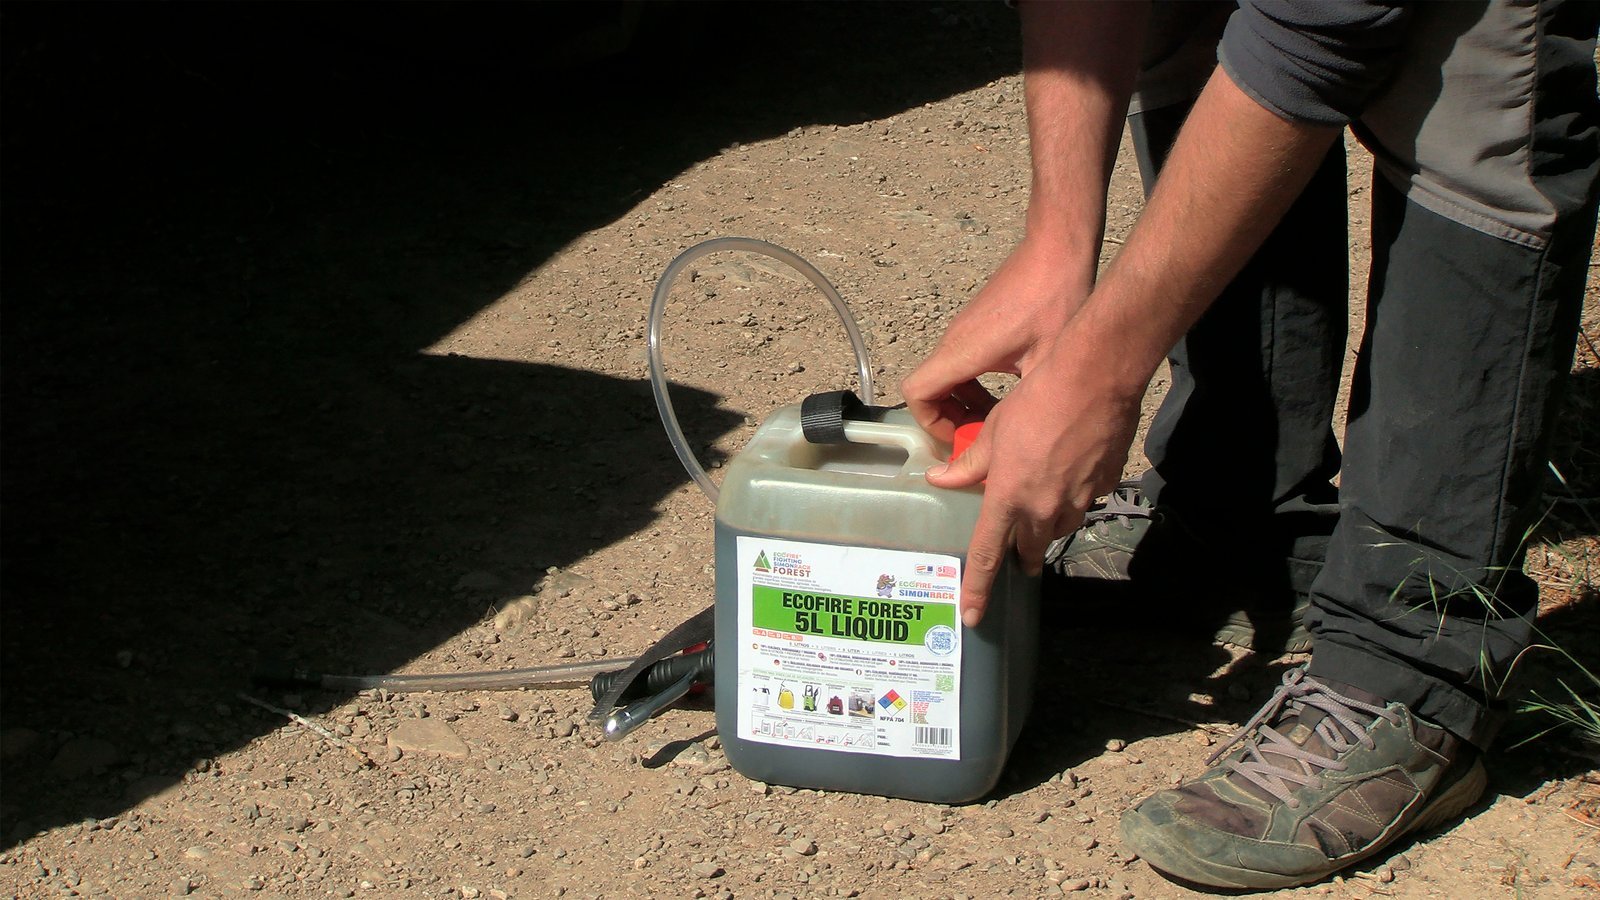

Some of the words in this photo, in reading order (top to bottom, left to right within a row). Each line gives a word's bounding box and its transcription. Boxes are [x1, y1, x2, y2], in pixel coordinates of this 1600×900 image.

[773, 561, 811, 570] SIMONRACK
[773, 567, 811, 577] FOREST
[899, 580, 932, 589] ECOFIRE
[899, 589, 955, 600] SIMONRACK
[782, 592, 852, 614] ECOFIRE
[858, 600, 924, 620] FOREST
[795, 611, 824, 634] 5L
[831, 615, 909, 641] LIQUID
